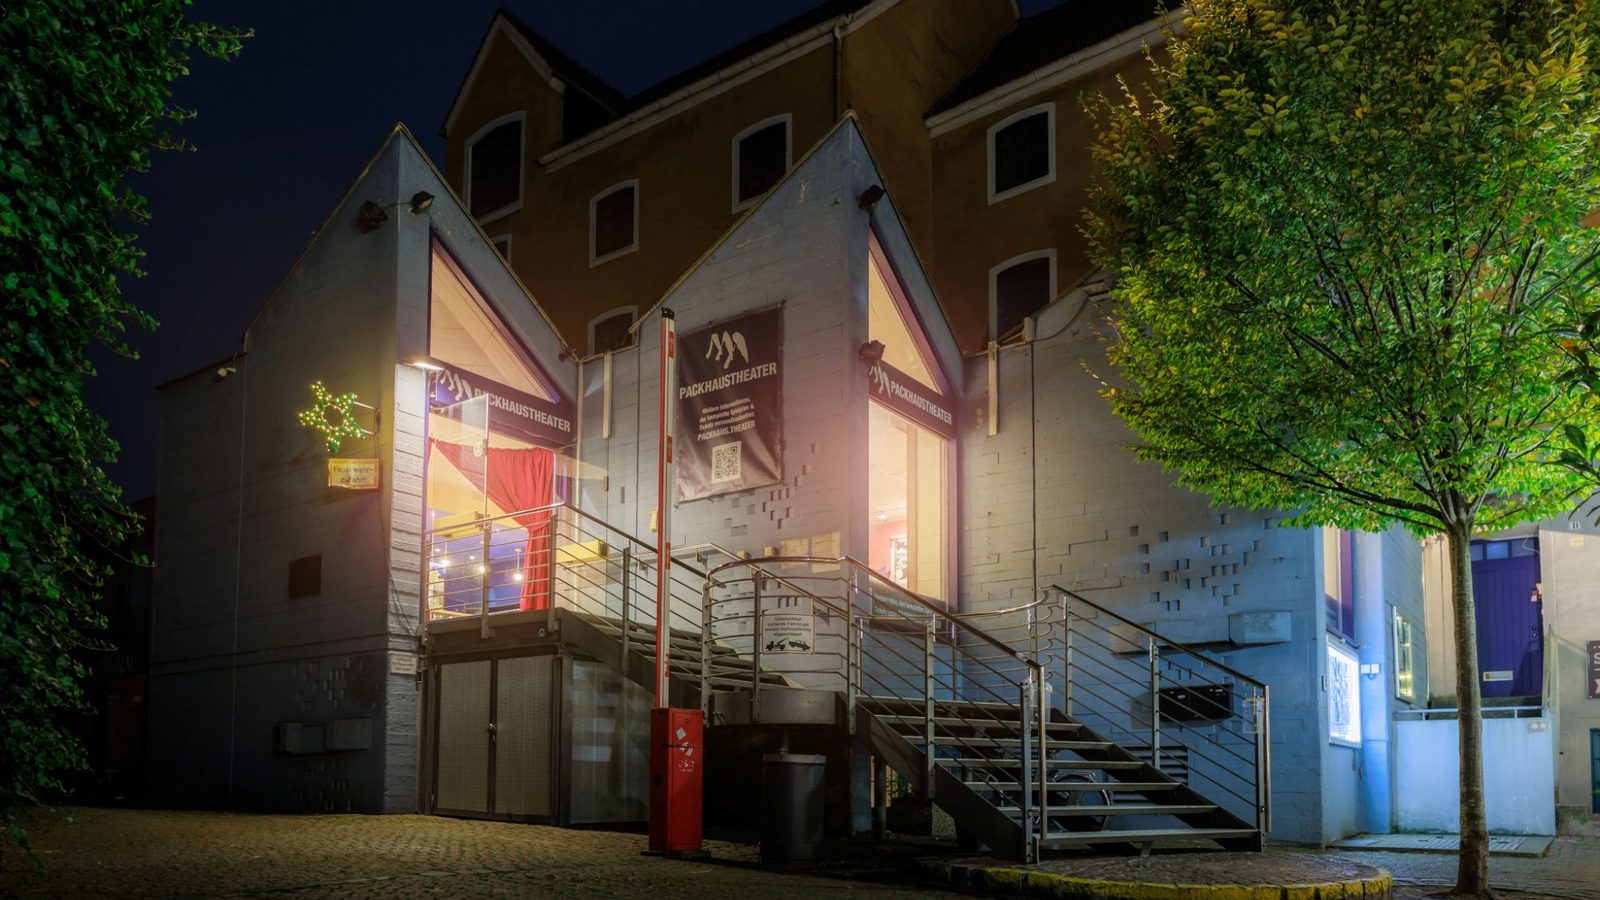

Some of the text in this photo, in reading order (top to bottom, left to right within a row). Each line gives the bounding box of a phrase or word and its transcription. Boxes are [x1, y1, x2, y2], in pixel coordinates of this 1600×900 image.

[679, 362, 777, 399] PACKHAUSTHEATER
[475, 388, 571, 433] PCKHAUSTHEATER
[891, 381, 953, 425] PACKHAUSTHEATER
[340, 475, 367, 484] zufahrt
